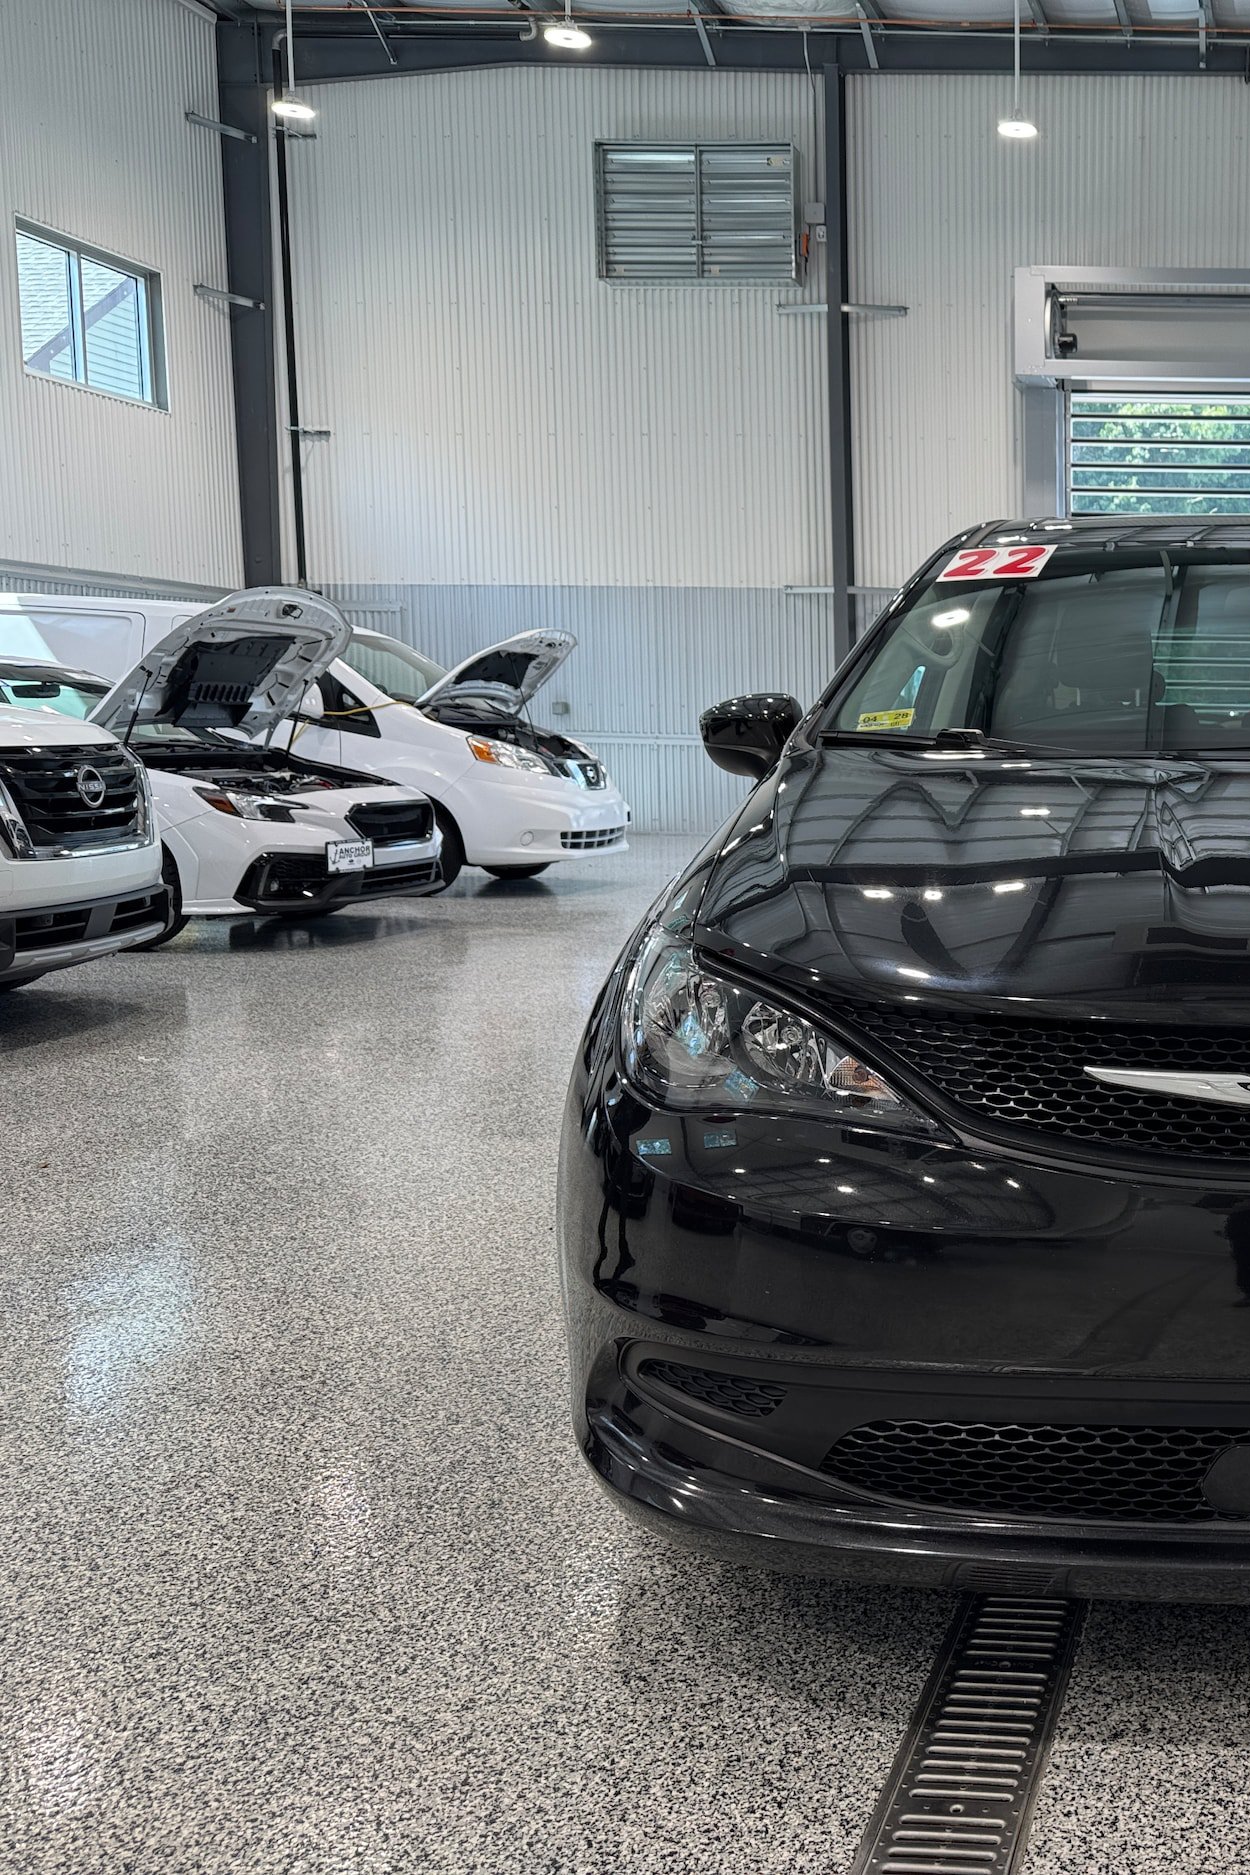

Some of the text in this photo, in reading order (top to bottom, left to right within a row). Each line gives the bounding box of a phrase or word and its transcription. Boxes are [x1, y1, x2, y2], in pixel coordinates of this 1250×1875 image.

[942, 547, 1048, 578] 22
[893, 712, 908, 720] 28
[339, 846, 370, 854] ANCHOR
